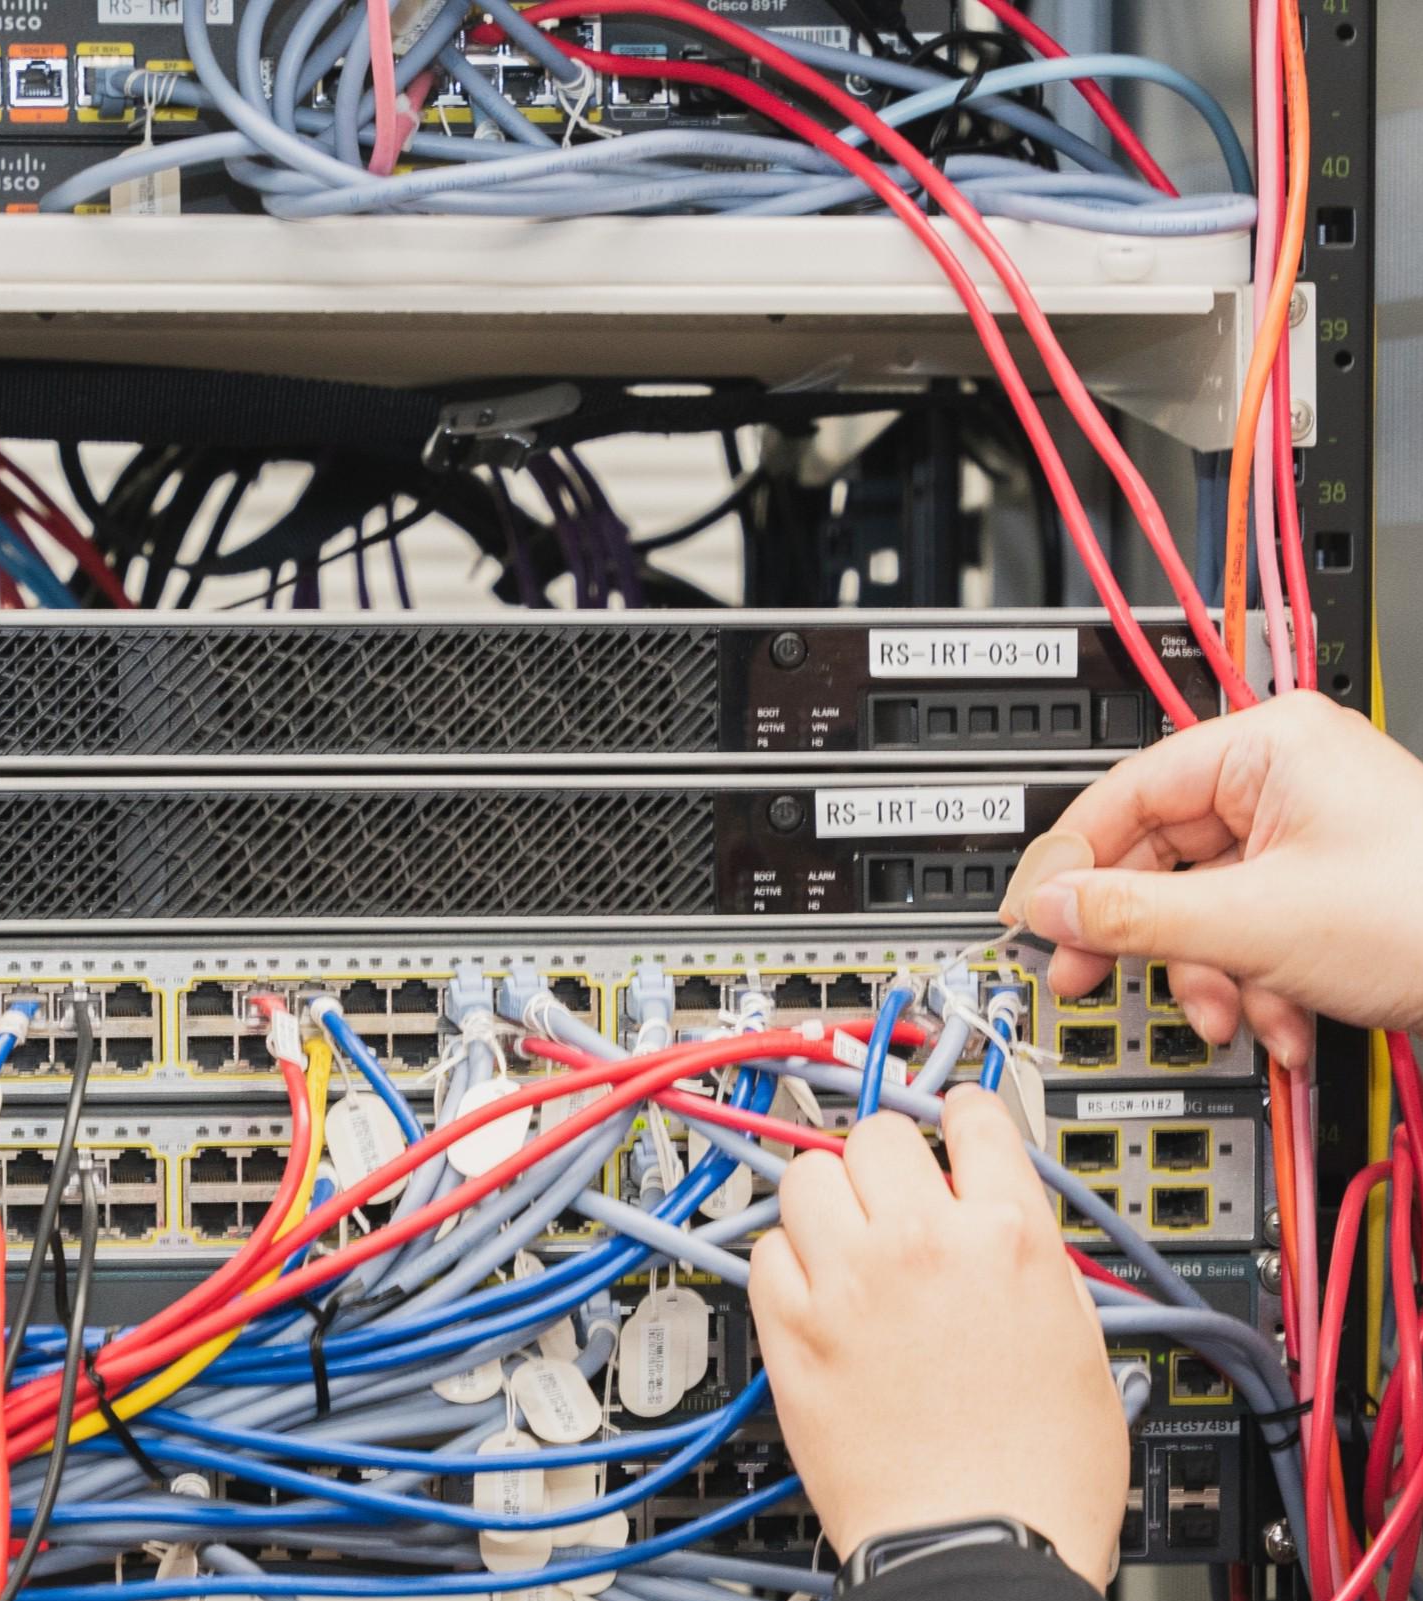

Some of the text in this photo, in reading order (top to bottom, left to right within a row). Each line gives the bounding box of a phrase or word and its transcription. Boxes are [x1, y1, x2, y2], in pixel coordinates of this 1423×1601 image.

[108, 0, 220, 16] RS-IRT3
[1321, 156, 1350, 179] 40
[1320, 320, 1349, 341] 39
[1319, 482, 1346, 504] 38
[1161, 636, 1187, 647] Cisco
[880, 642, 1061, 666] RS-IRT-03-01
[1316, 642, 1345, 665] 37
[757, 707, 780, 718] BOOT
[811, 707, 840, 718] ALARM
[757, 722, 785, 733] ACTIVE
[811, 722, 829, 733] VPN
[826, 797, 1011, 826] RS-IRT-03-02
[753, 870, 777, 882] BOOT
[808, 870, 836, 882] ALARM
[753, 885, 782, 896] ACTIVE
[808, 885, 825, 896] VPN
[1207, 1104, 1234, 1113] SERIES
[1172, 1264, 1202, 1276] 960
[1208, 1264, 1245, 1276] Series
